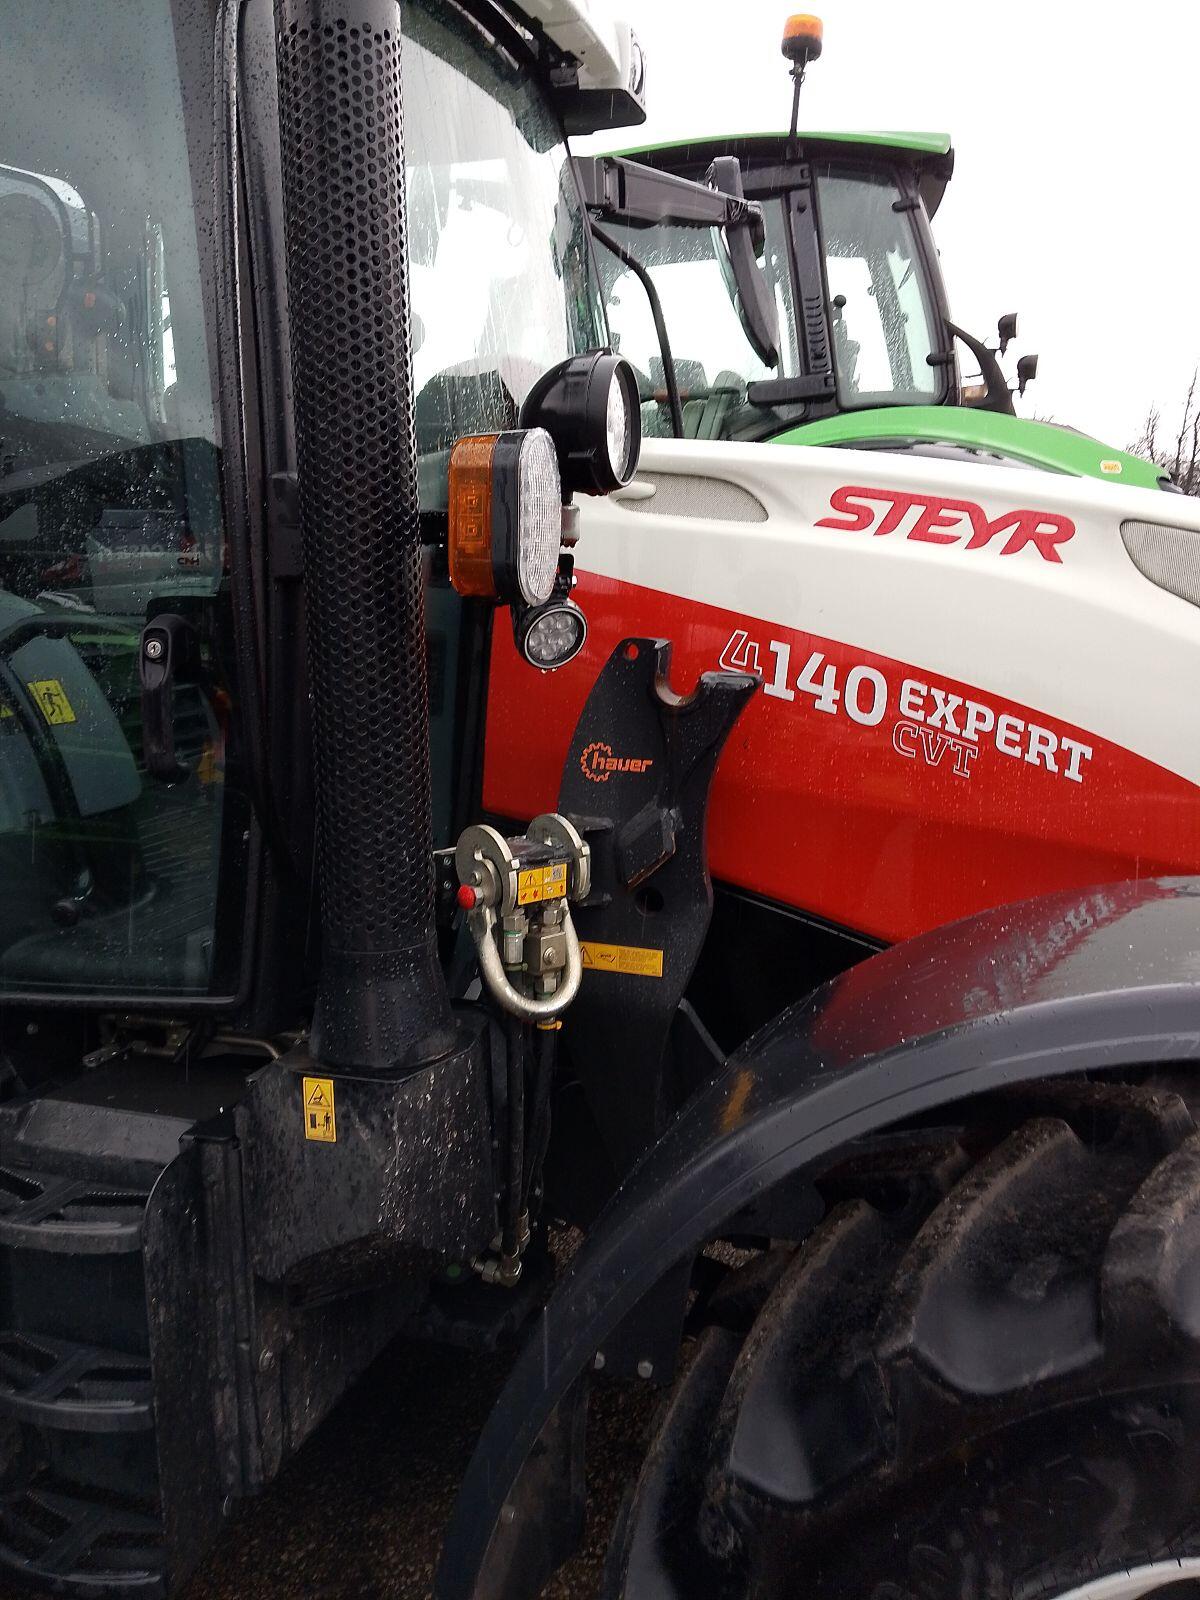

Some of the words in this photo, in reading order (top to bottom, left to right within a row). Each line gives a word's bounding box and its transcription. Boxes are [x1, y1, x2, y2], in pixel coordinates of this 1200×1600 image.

[814, 486, 1076, 563] STEYR
[718, 629, 888, 727] 4140
[899, 678, 1093, 784] EXPERT
[591, 750, 653, 773] hauer
[892, 720, 979, 779] CVT
